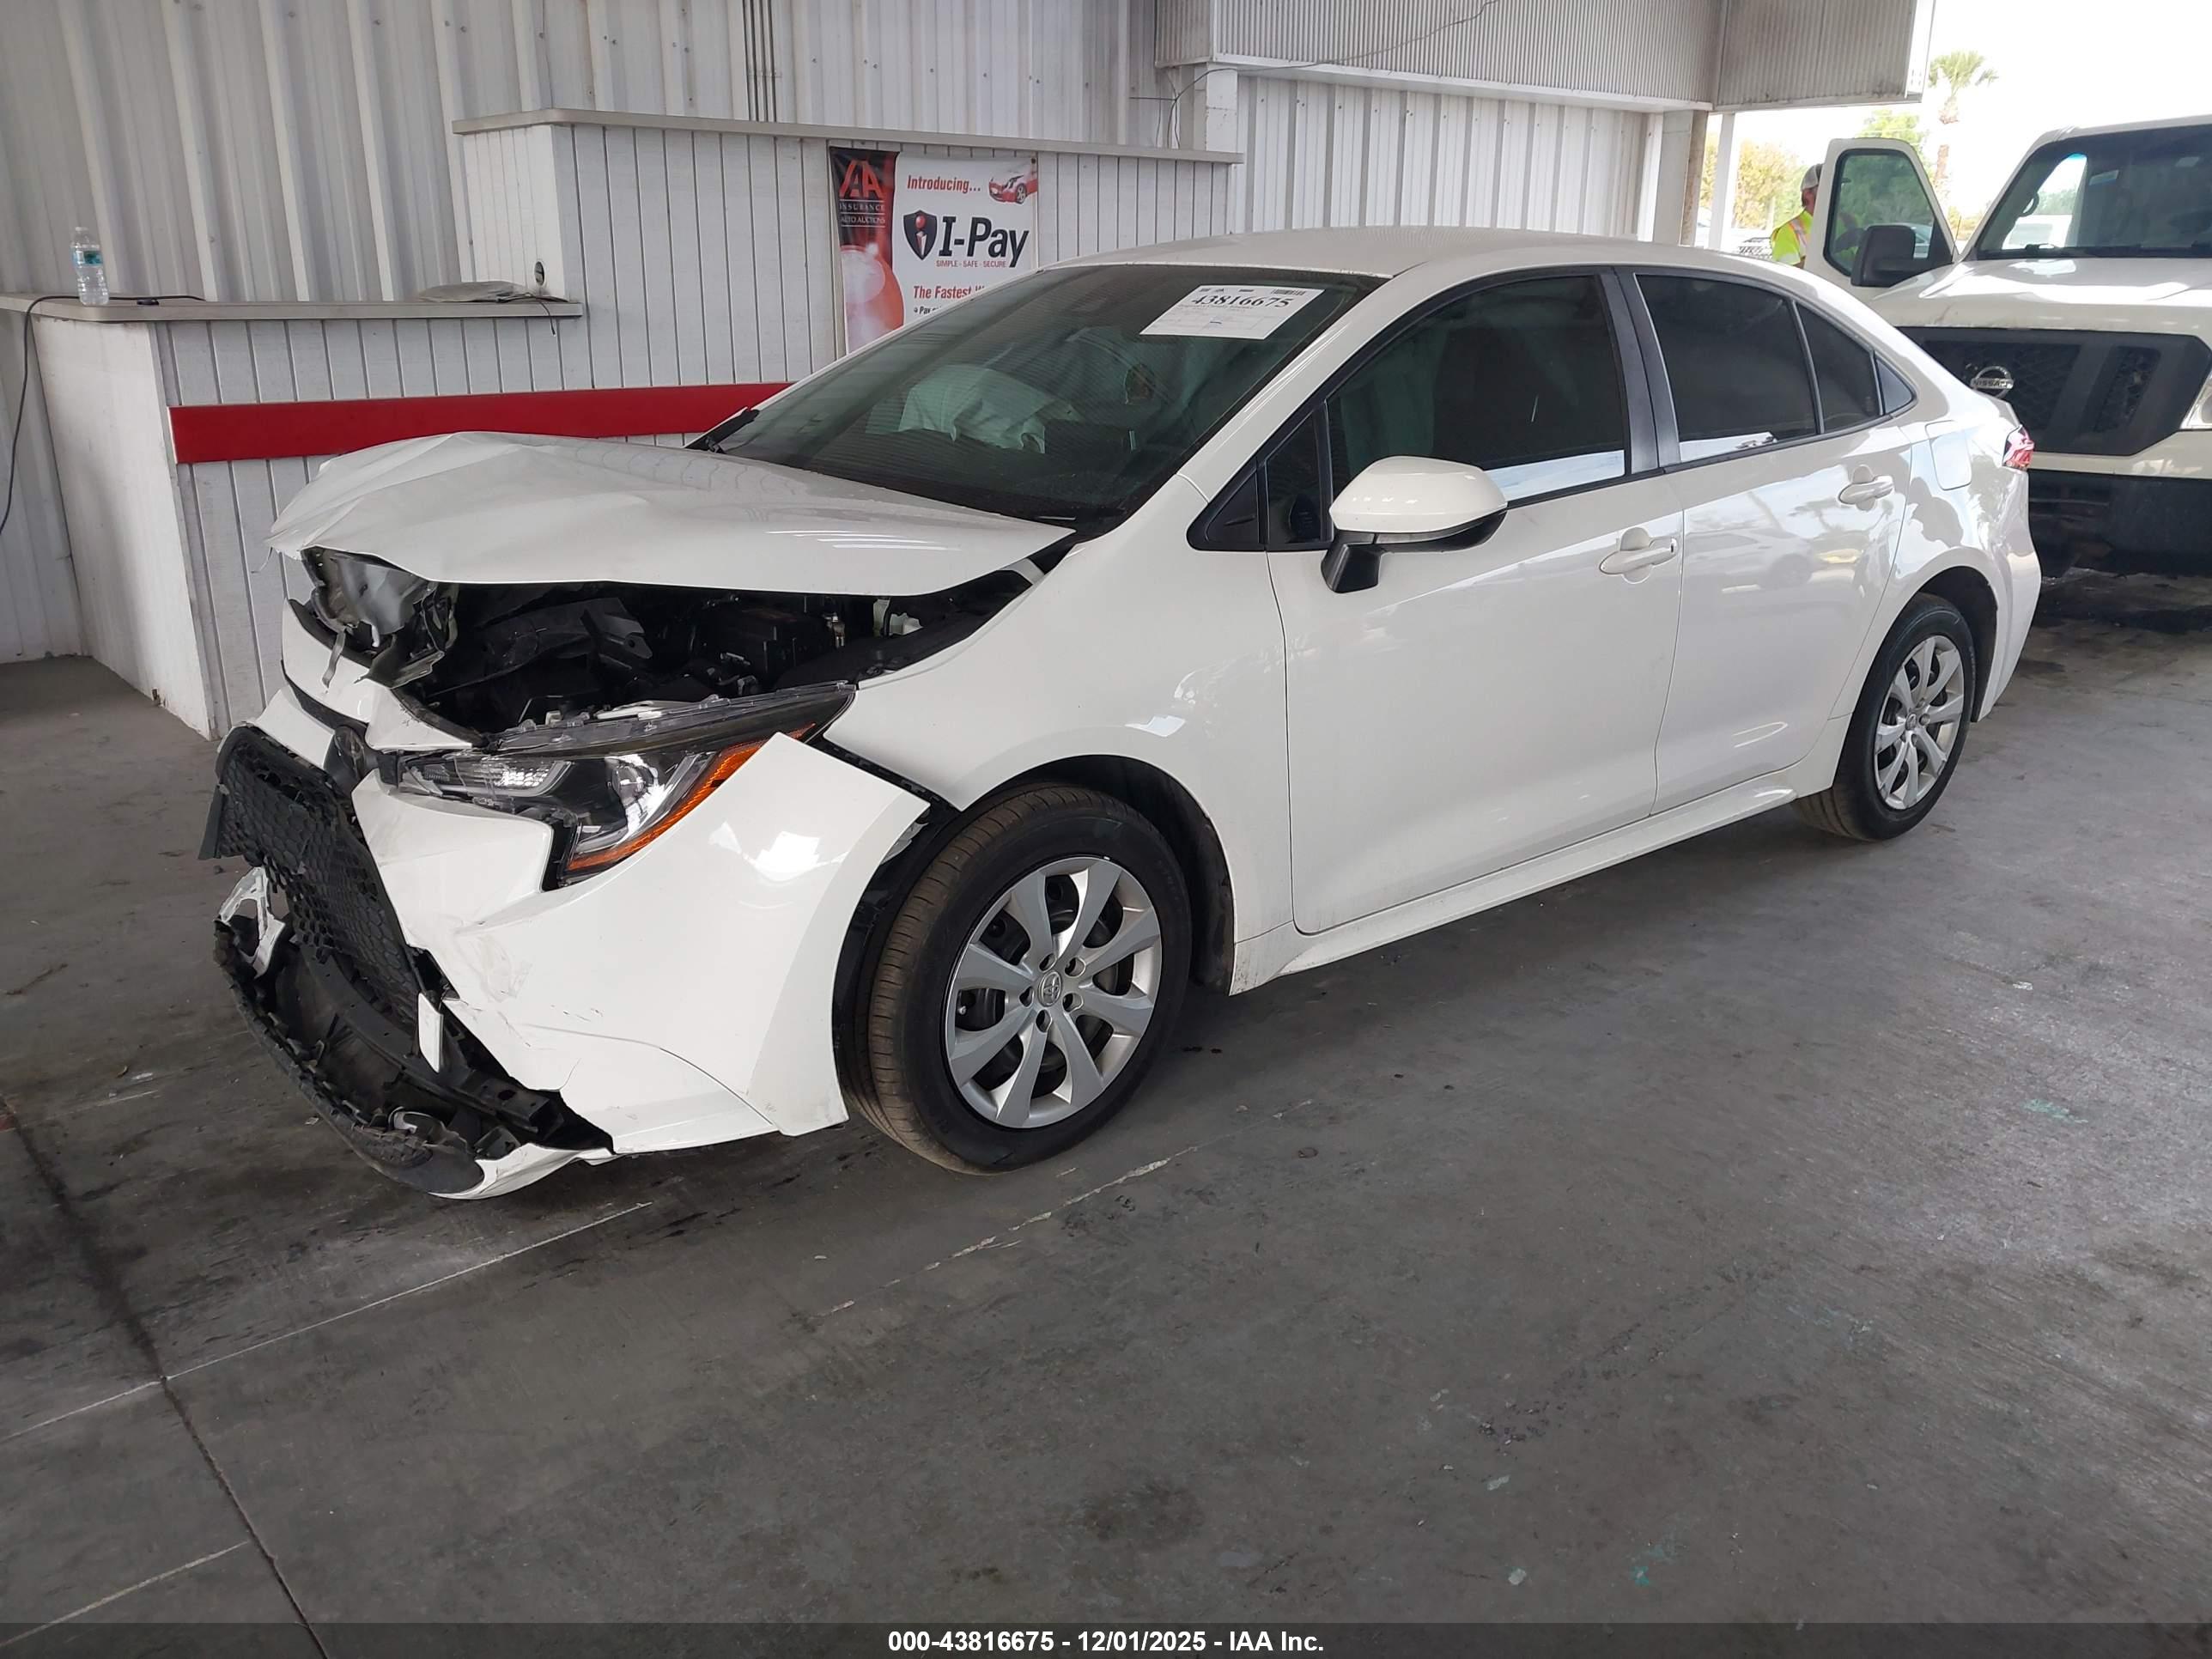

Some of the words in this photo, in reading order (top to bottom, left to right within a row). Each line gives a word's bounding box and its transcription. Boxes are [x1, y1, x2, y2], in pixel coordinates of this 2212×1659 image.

[907, 175, 981, 194] Introducing...
[839, 203, 885, 211] INSURANCE
[857, 216, 885, 224] AUCTIONS
[939, 216, 1030, 268] I-Pay
[914, 285, 932, 299] The
[934, 285, 971, 299] Fastest
[1192, 295, 1293, 307] 43816675
